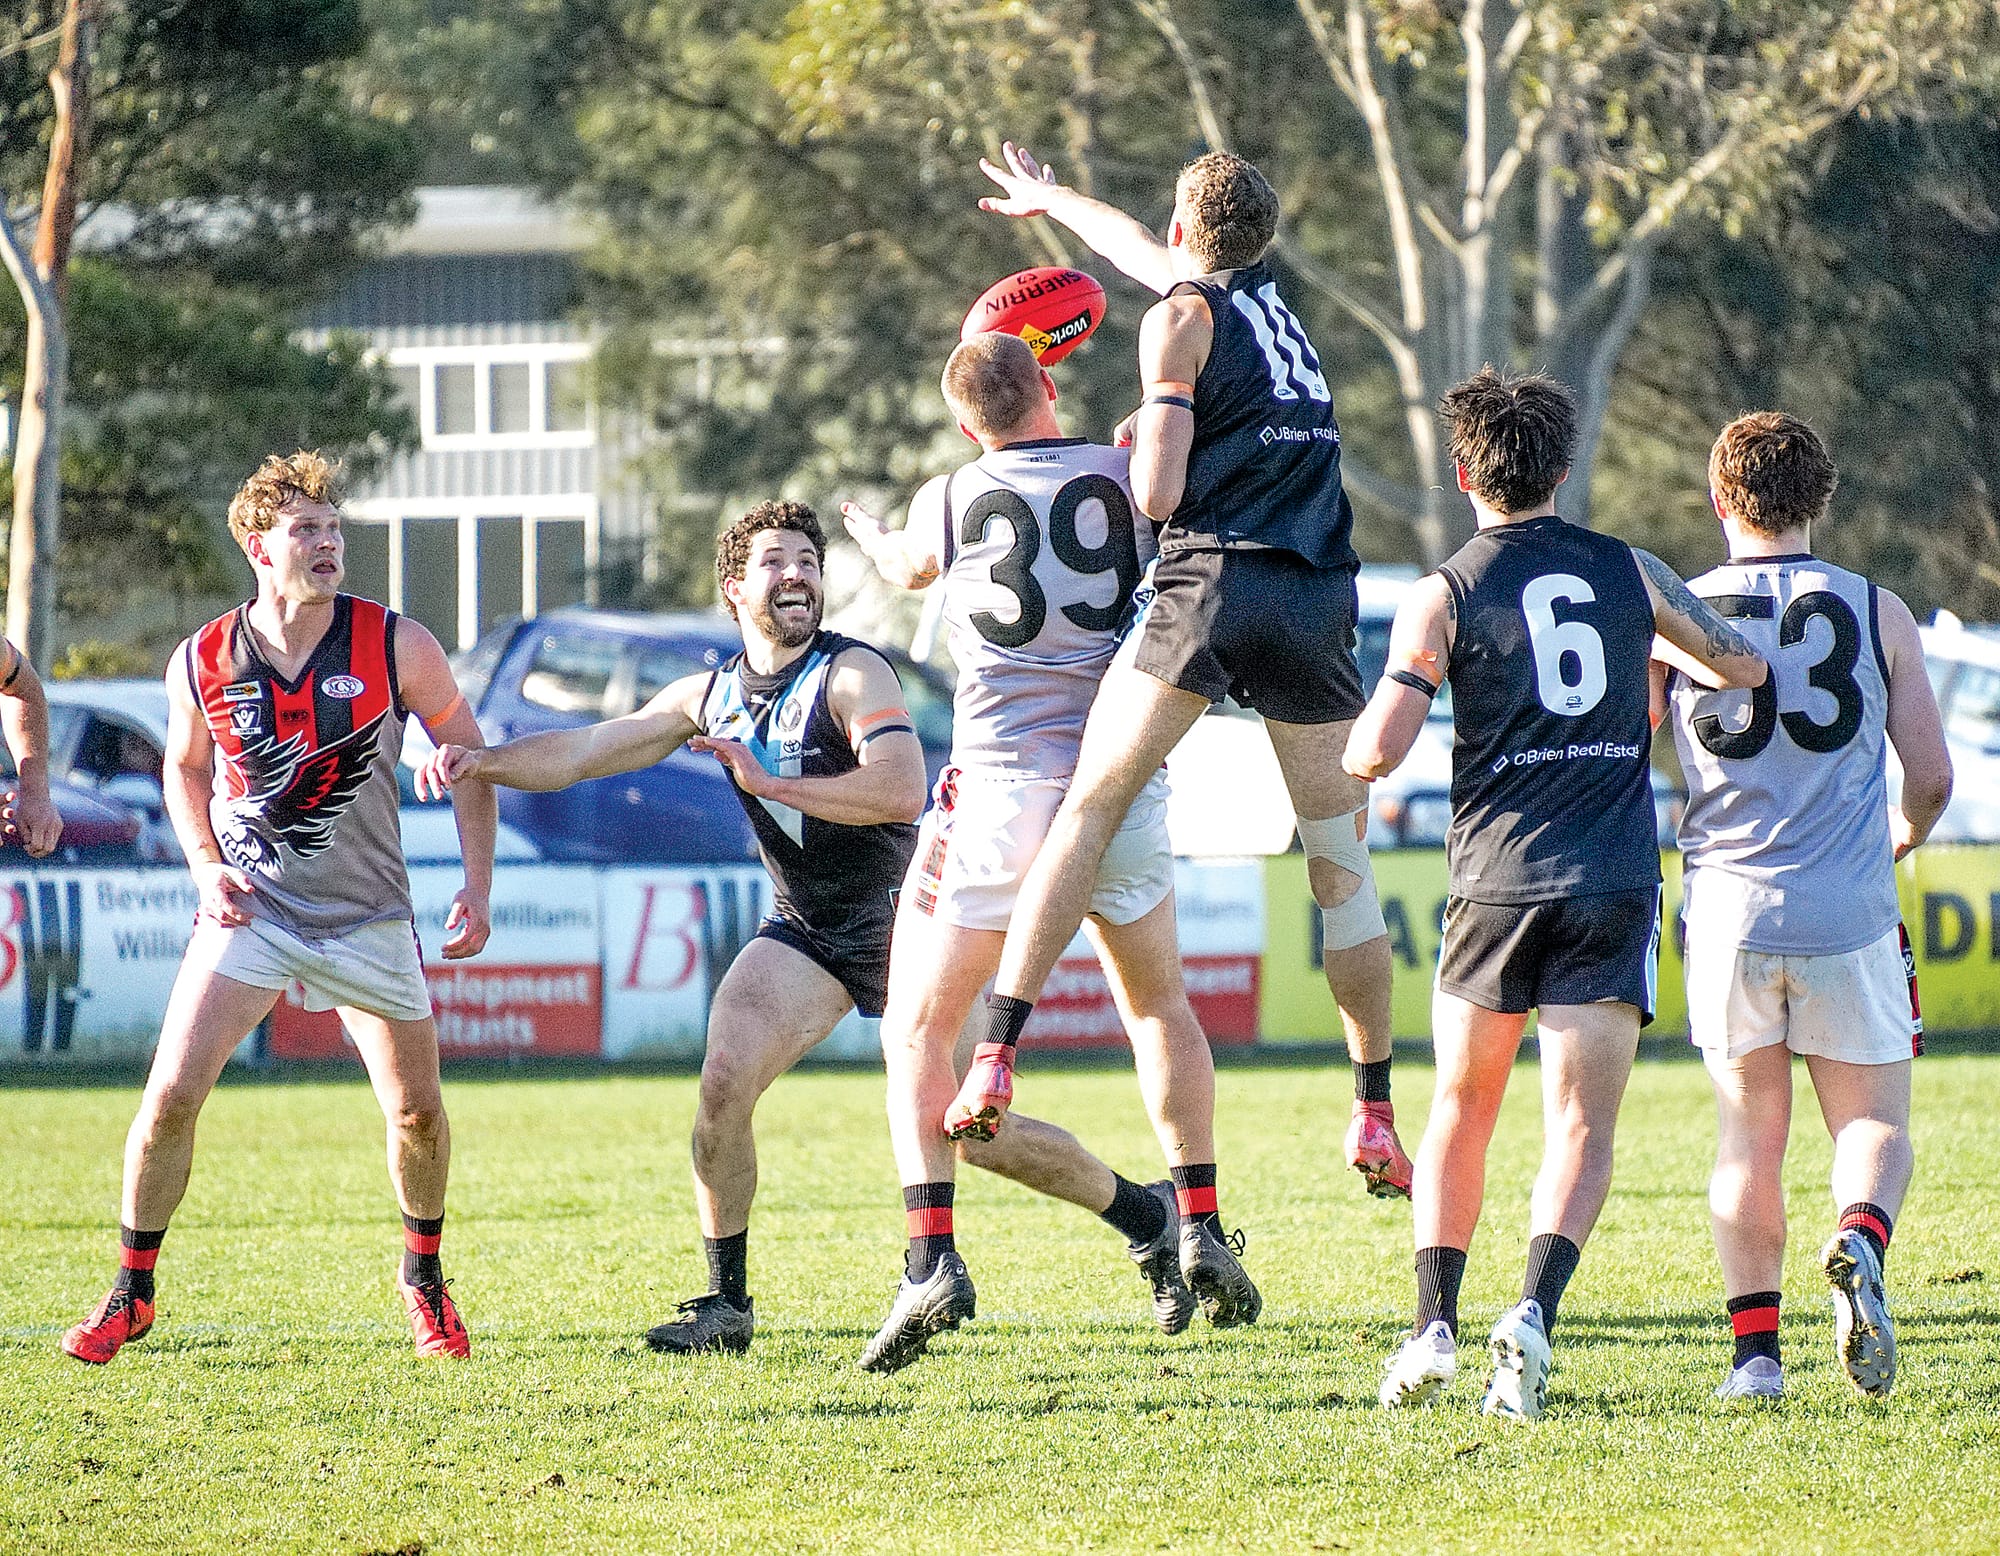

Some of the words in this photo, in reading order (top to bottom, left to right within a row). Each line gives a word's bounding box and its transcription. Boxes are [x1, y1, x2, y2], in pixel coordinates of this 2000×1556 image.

[986, 271, 1083, 314] SHERRIN
[1232, 281, 1332, 402] 10
[962, 474, 1145, 648] 39
[1521, 572, 1607, 717] 6
[1693, 589, 1865, 761] 53
[1514, 747, 1565, 766] OBrien
[1567, 741, 1603, 760] Real
